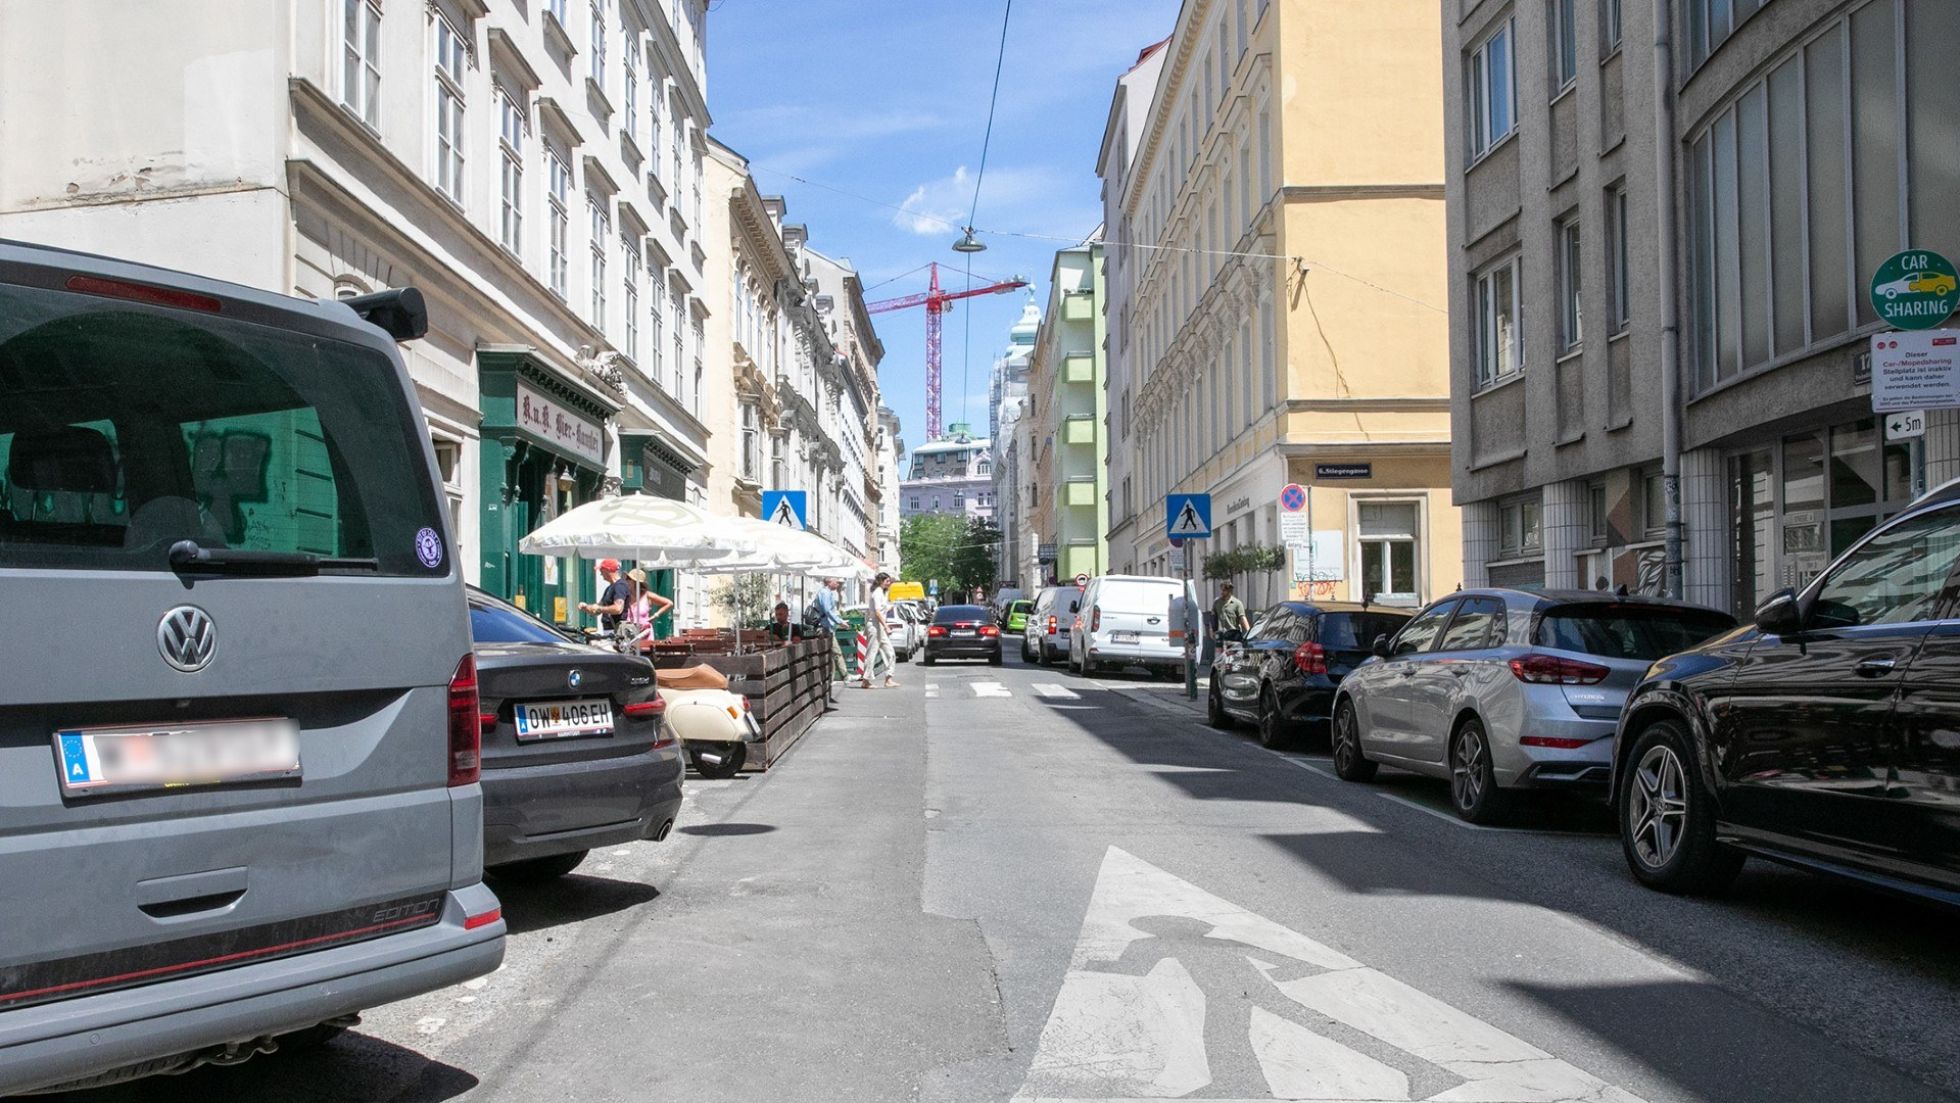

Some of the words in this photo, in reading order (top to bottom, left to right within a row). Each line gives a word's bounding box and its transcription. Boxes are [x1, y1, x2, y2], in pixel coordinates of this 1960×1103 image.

[1901, 254, 1928, 270] CAR
[1884, 299, 1948, 317] SHARING
[1883, 366, 1916, 375] Stellplatz
[529, 707, 550, 728] OW
[562, 704, 588, 726] 406
[591, 703, 608, 724] EH
[72, 763, 83, 775] A
